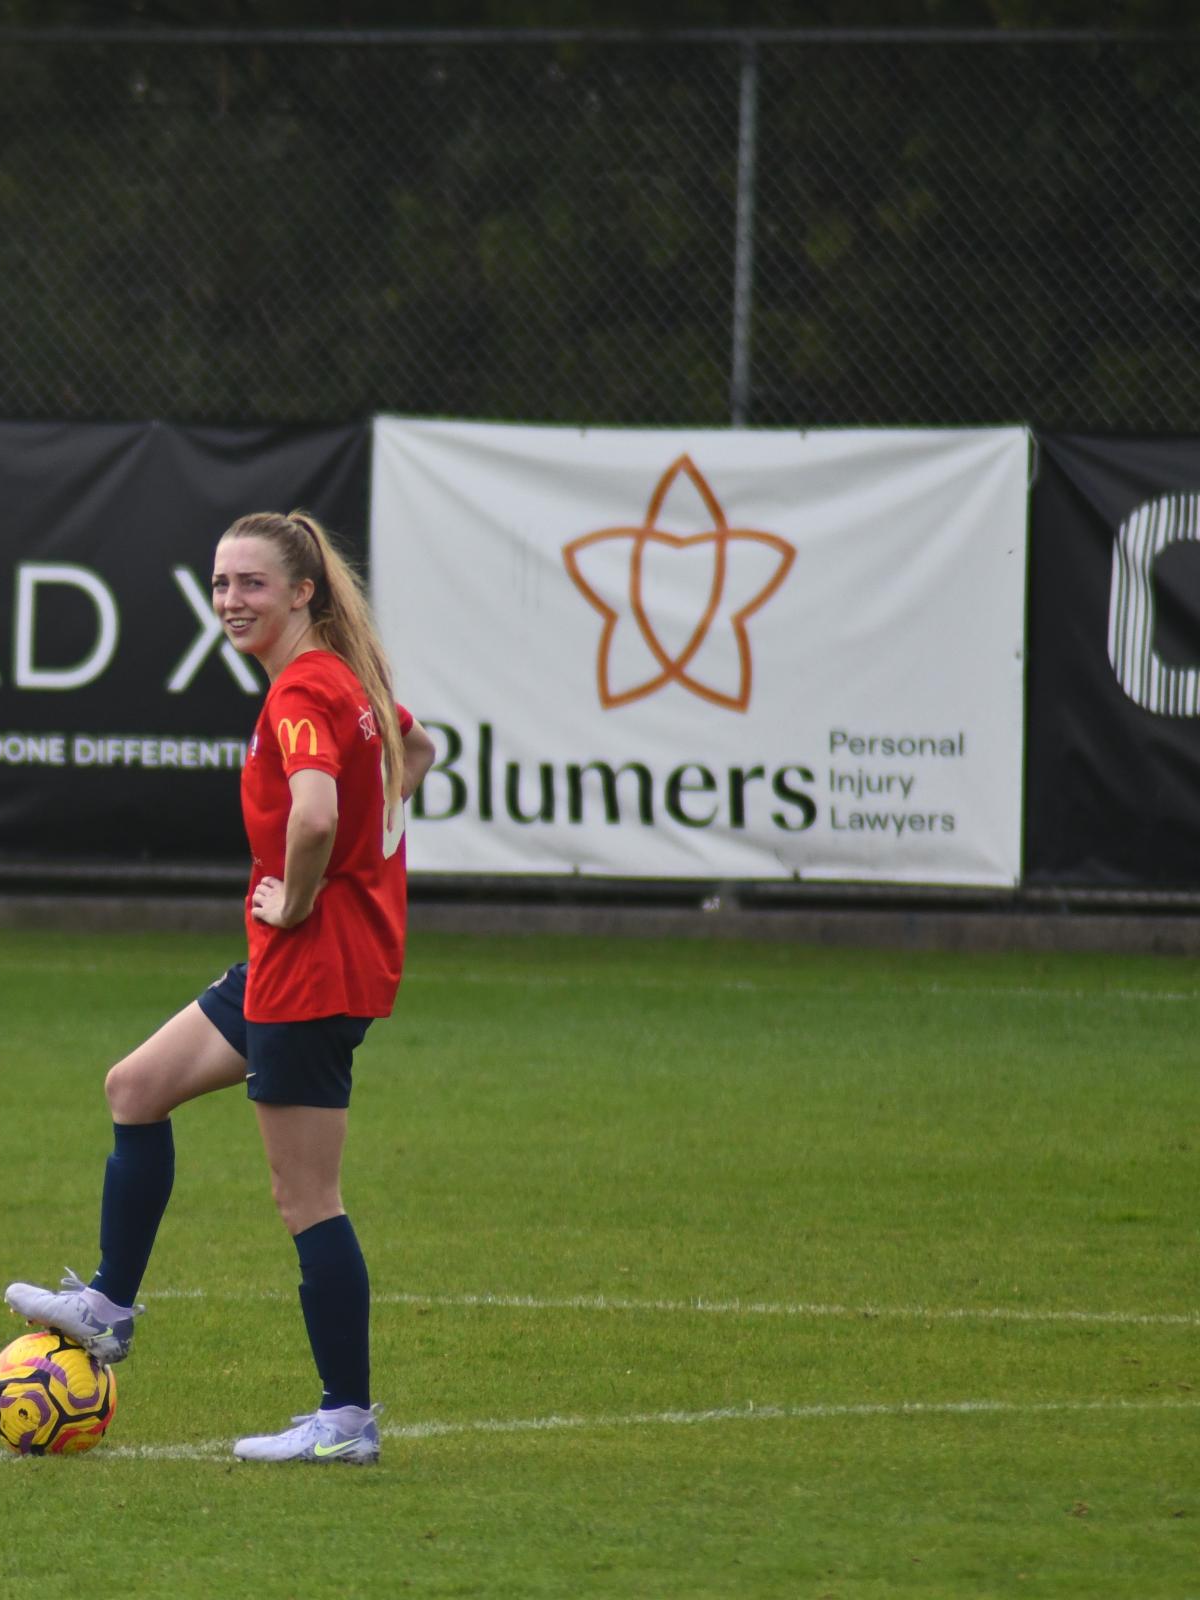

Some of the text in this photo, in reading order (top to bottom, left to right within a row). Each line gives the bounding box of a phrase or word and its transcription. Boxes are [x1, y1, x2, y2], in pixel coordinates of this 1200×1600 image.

[166, 564, 262, 694] X
[829, 730, 964, 757] Personal
[411, 720, 818, 832] Blumers
[829, 767, 914, 800] Injury
[830, 805, 956, 838] Lawyers
